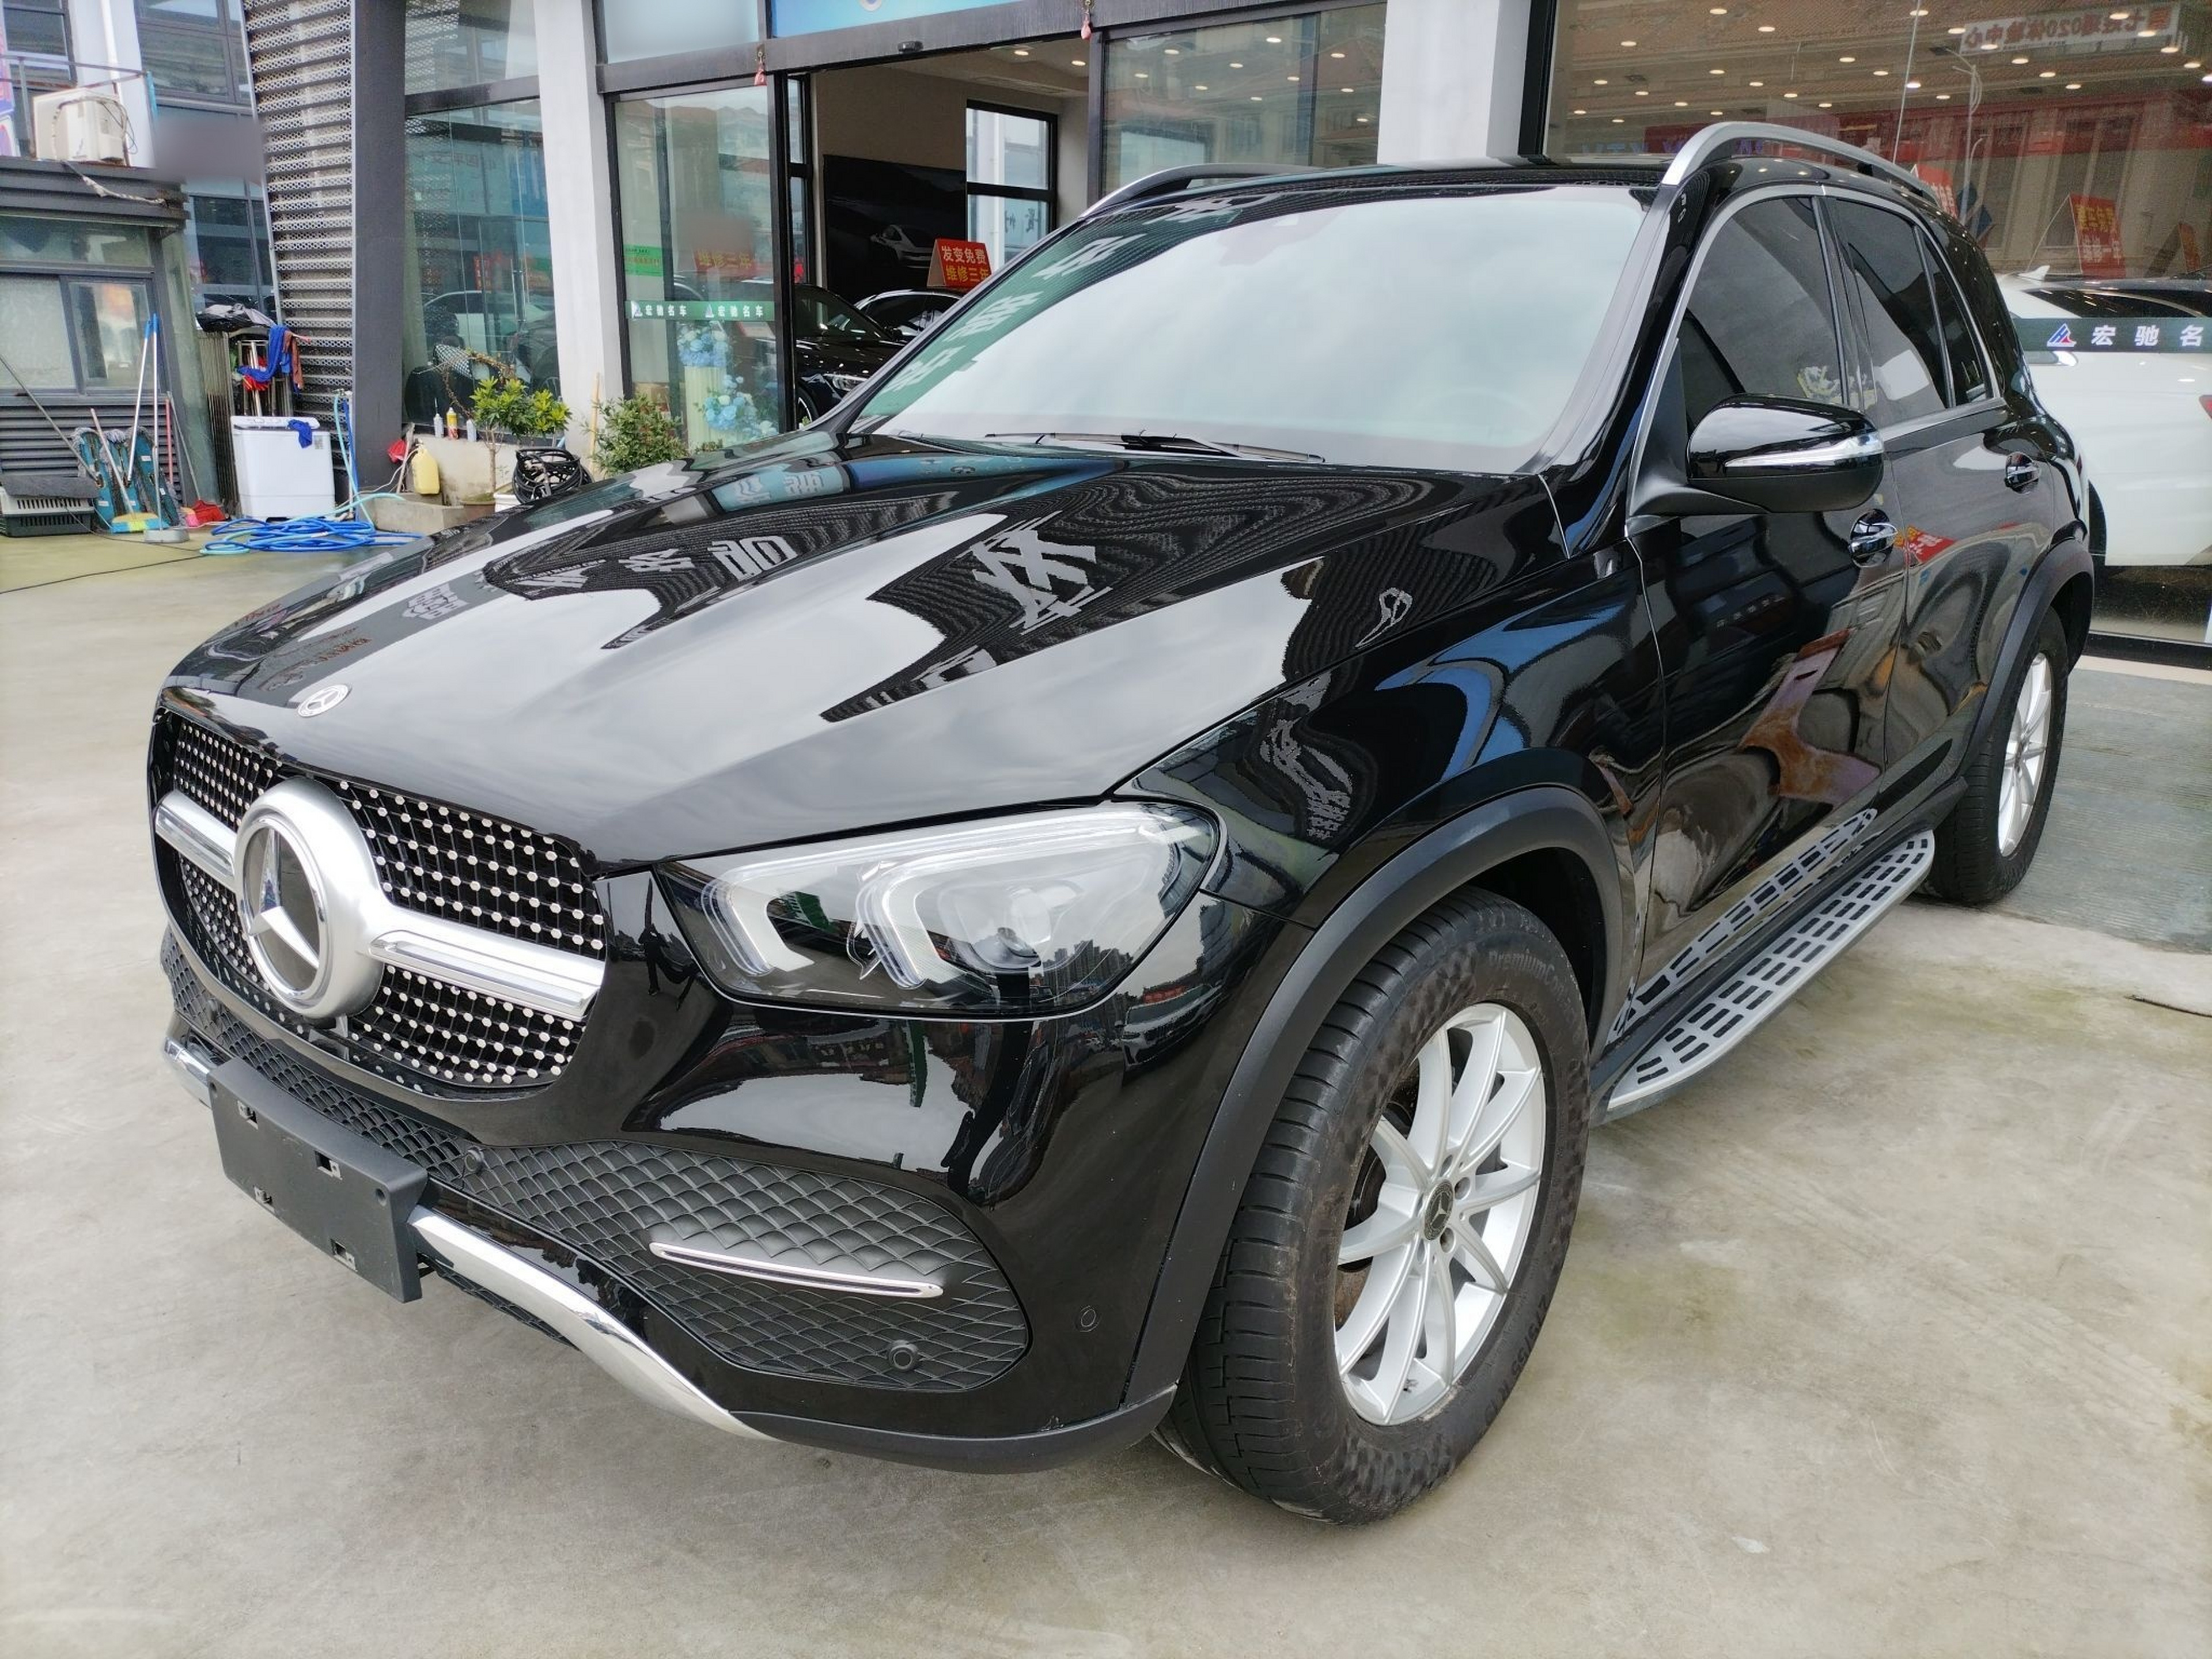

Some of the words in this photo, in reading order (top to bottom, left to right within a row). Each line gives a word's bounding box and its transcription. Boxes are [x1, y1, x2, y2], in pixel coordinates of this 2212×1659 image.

[941, 245, 987, 264] 发变免费
[2091, 324, 2204, 346] 宏驰名
